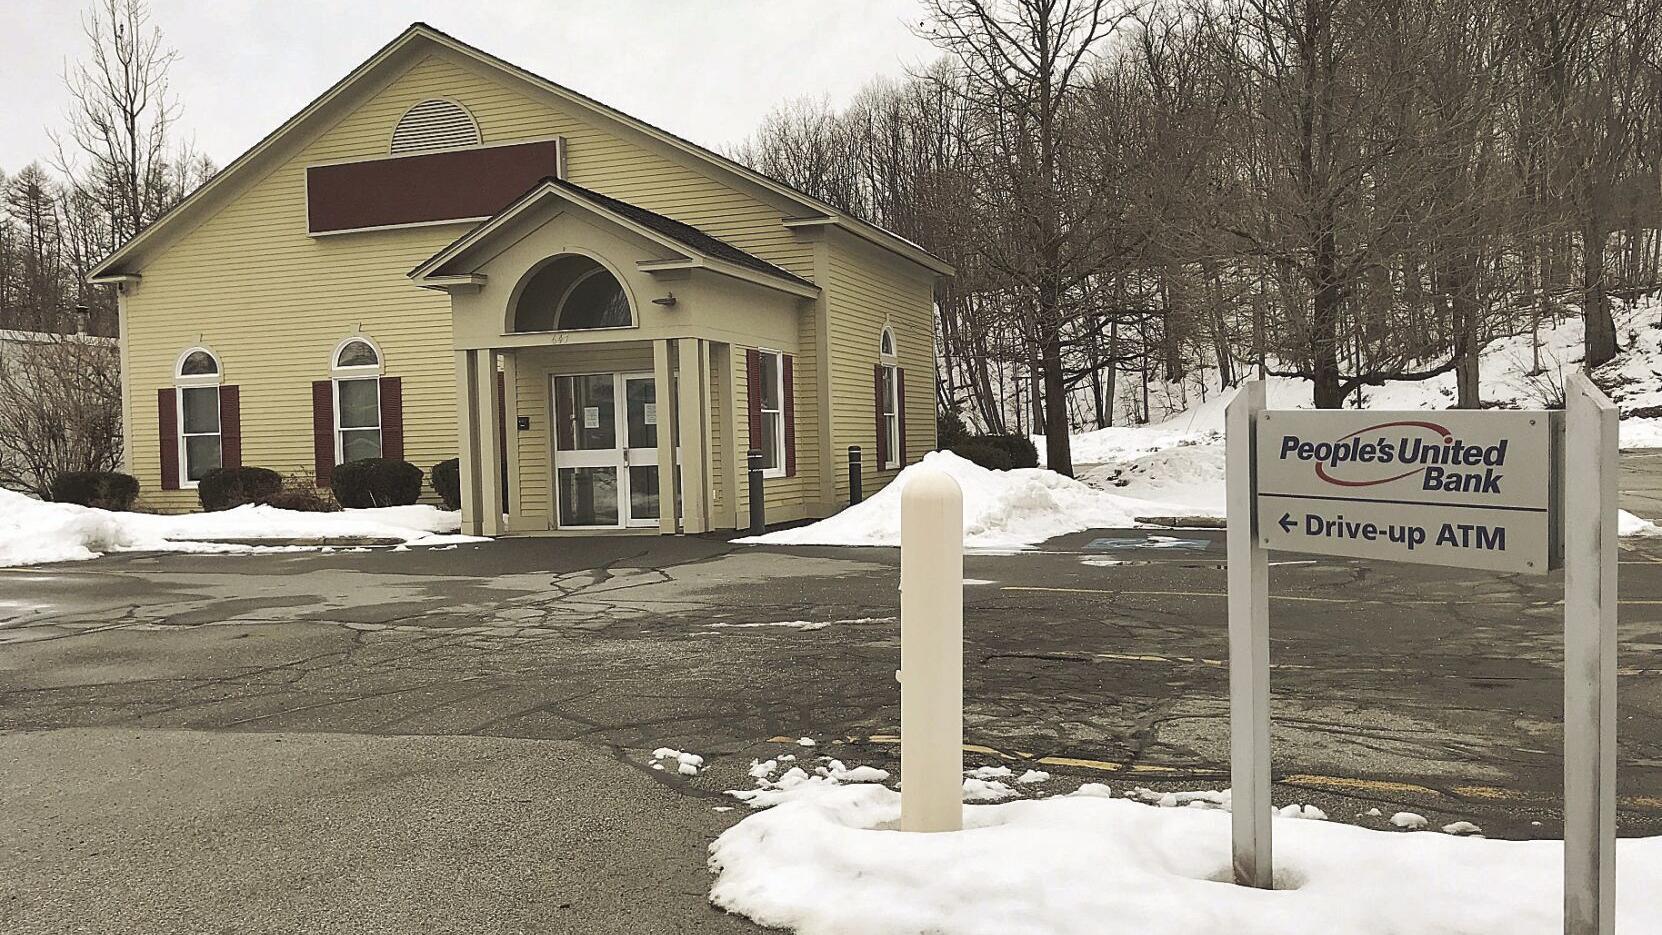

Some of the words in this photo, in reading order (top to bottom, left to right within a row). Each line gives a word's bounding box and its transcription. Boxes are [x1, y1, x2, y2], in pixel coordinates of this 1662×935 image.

[1280, 436, 1394, 467] People's
[1398, 438, 1508, 466] United
[1422, 467, 1503, 494] Bank
[1305, 514, 1426, 549] Drive-up
[1436, 523, 1506, 551] ATM
